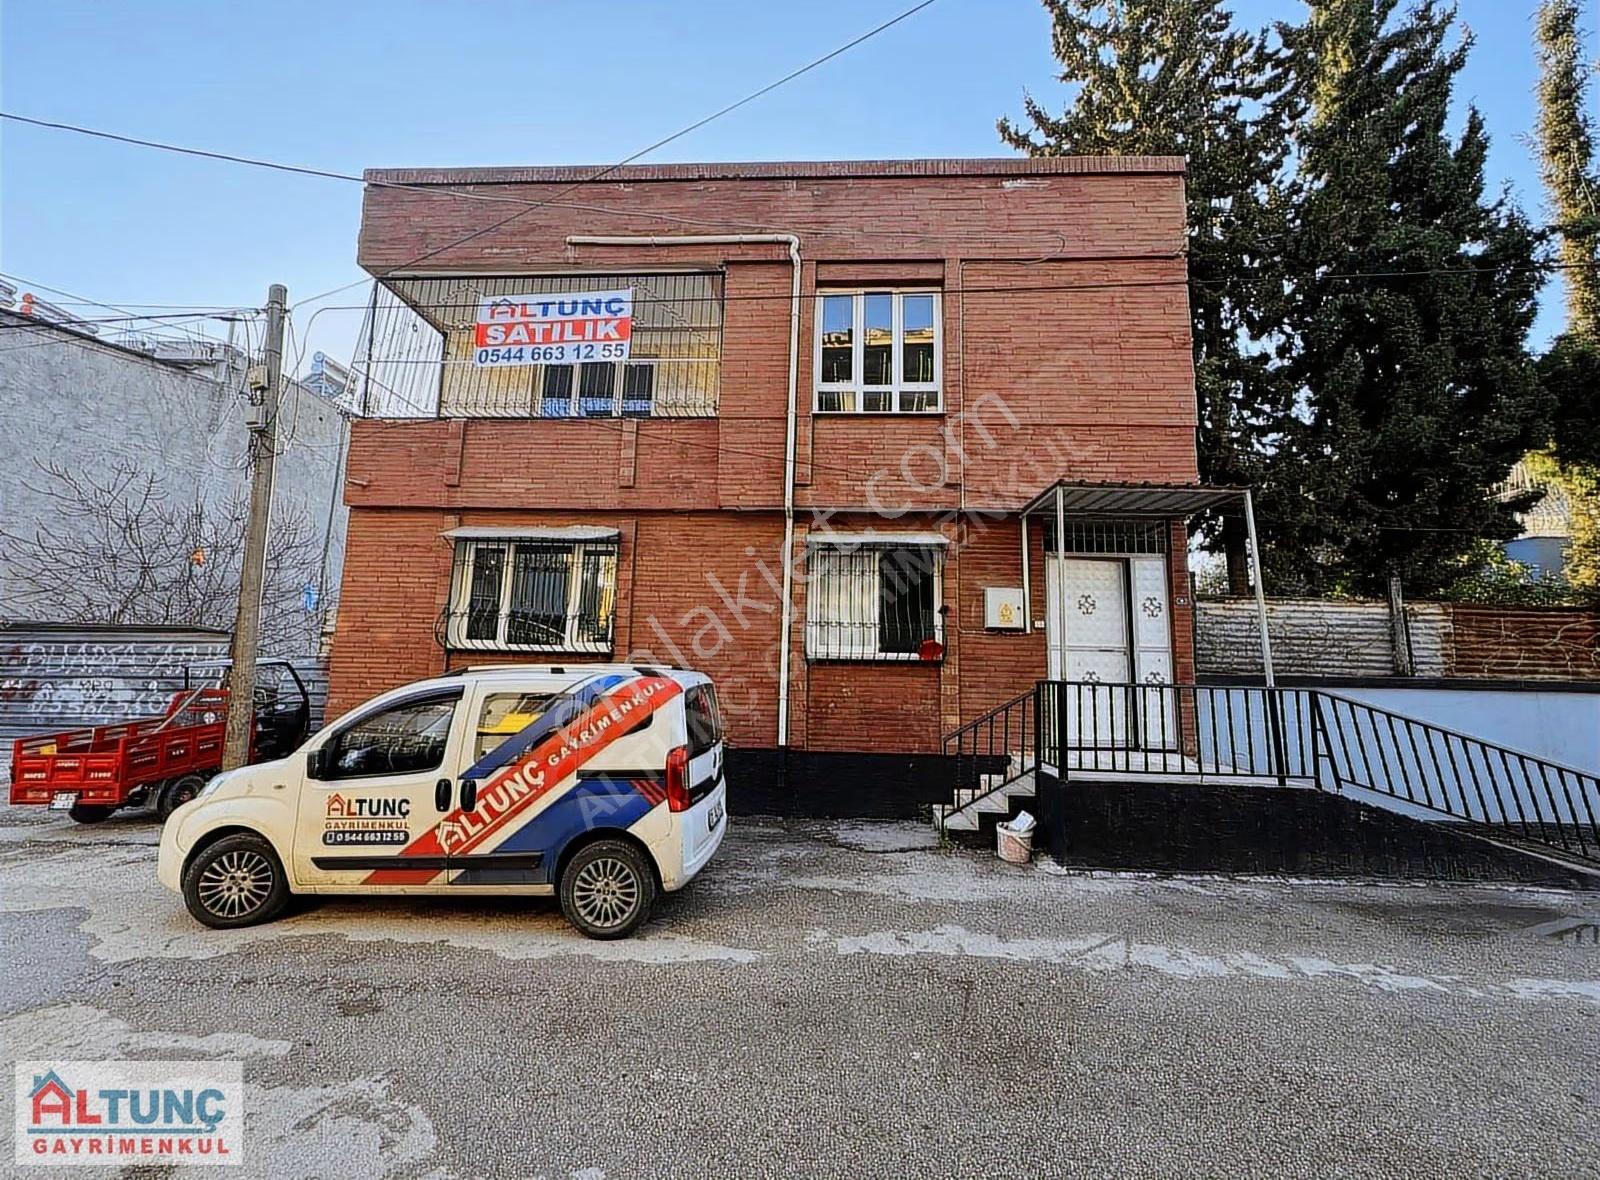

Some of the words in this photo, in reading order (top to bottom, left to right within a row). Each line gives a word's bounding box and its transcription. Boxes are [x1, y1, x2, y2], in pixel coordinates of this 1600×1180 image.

[489, 297, 625, 319] ALTUNÇ
[486, 319, 619, 345] SATILIK
[478, 347, 524, 364] 0544
[531, 346, 565, 361] 663
[573, 344, 595, 360] 12
[601, 343, 625, 358] 55
[327, 793, 410, 819] ALTUNÇ
[434, 759, 545, 856] ALTUNÇ
